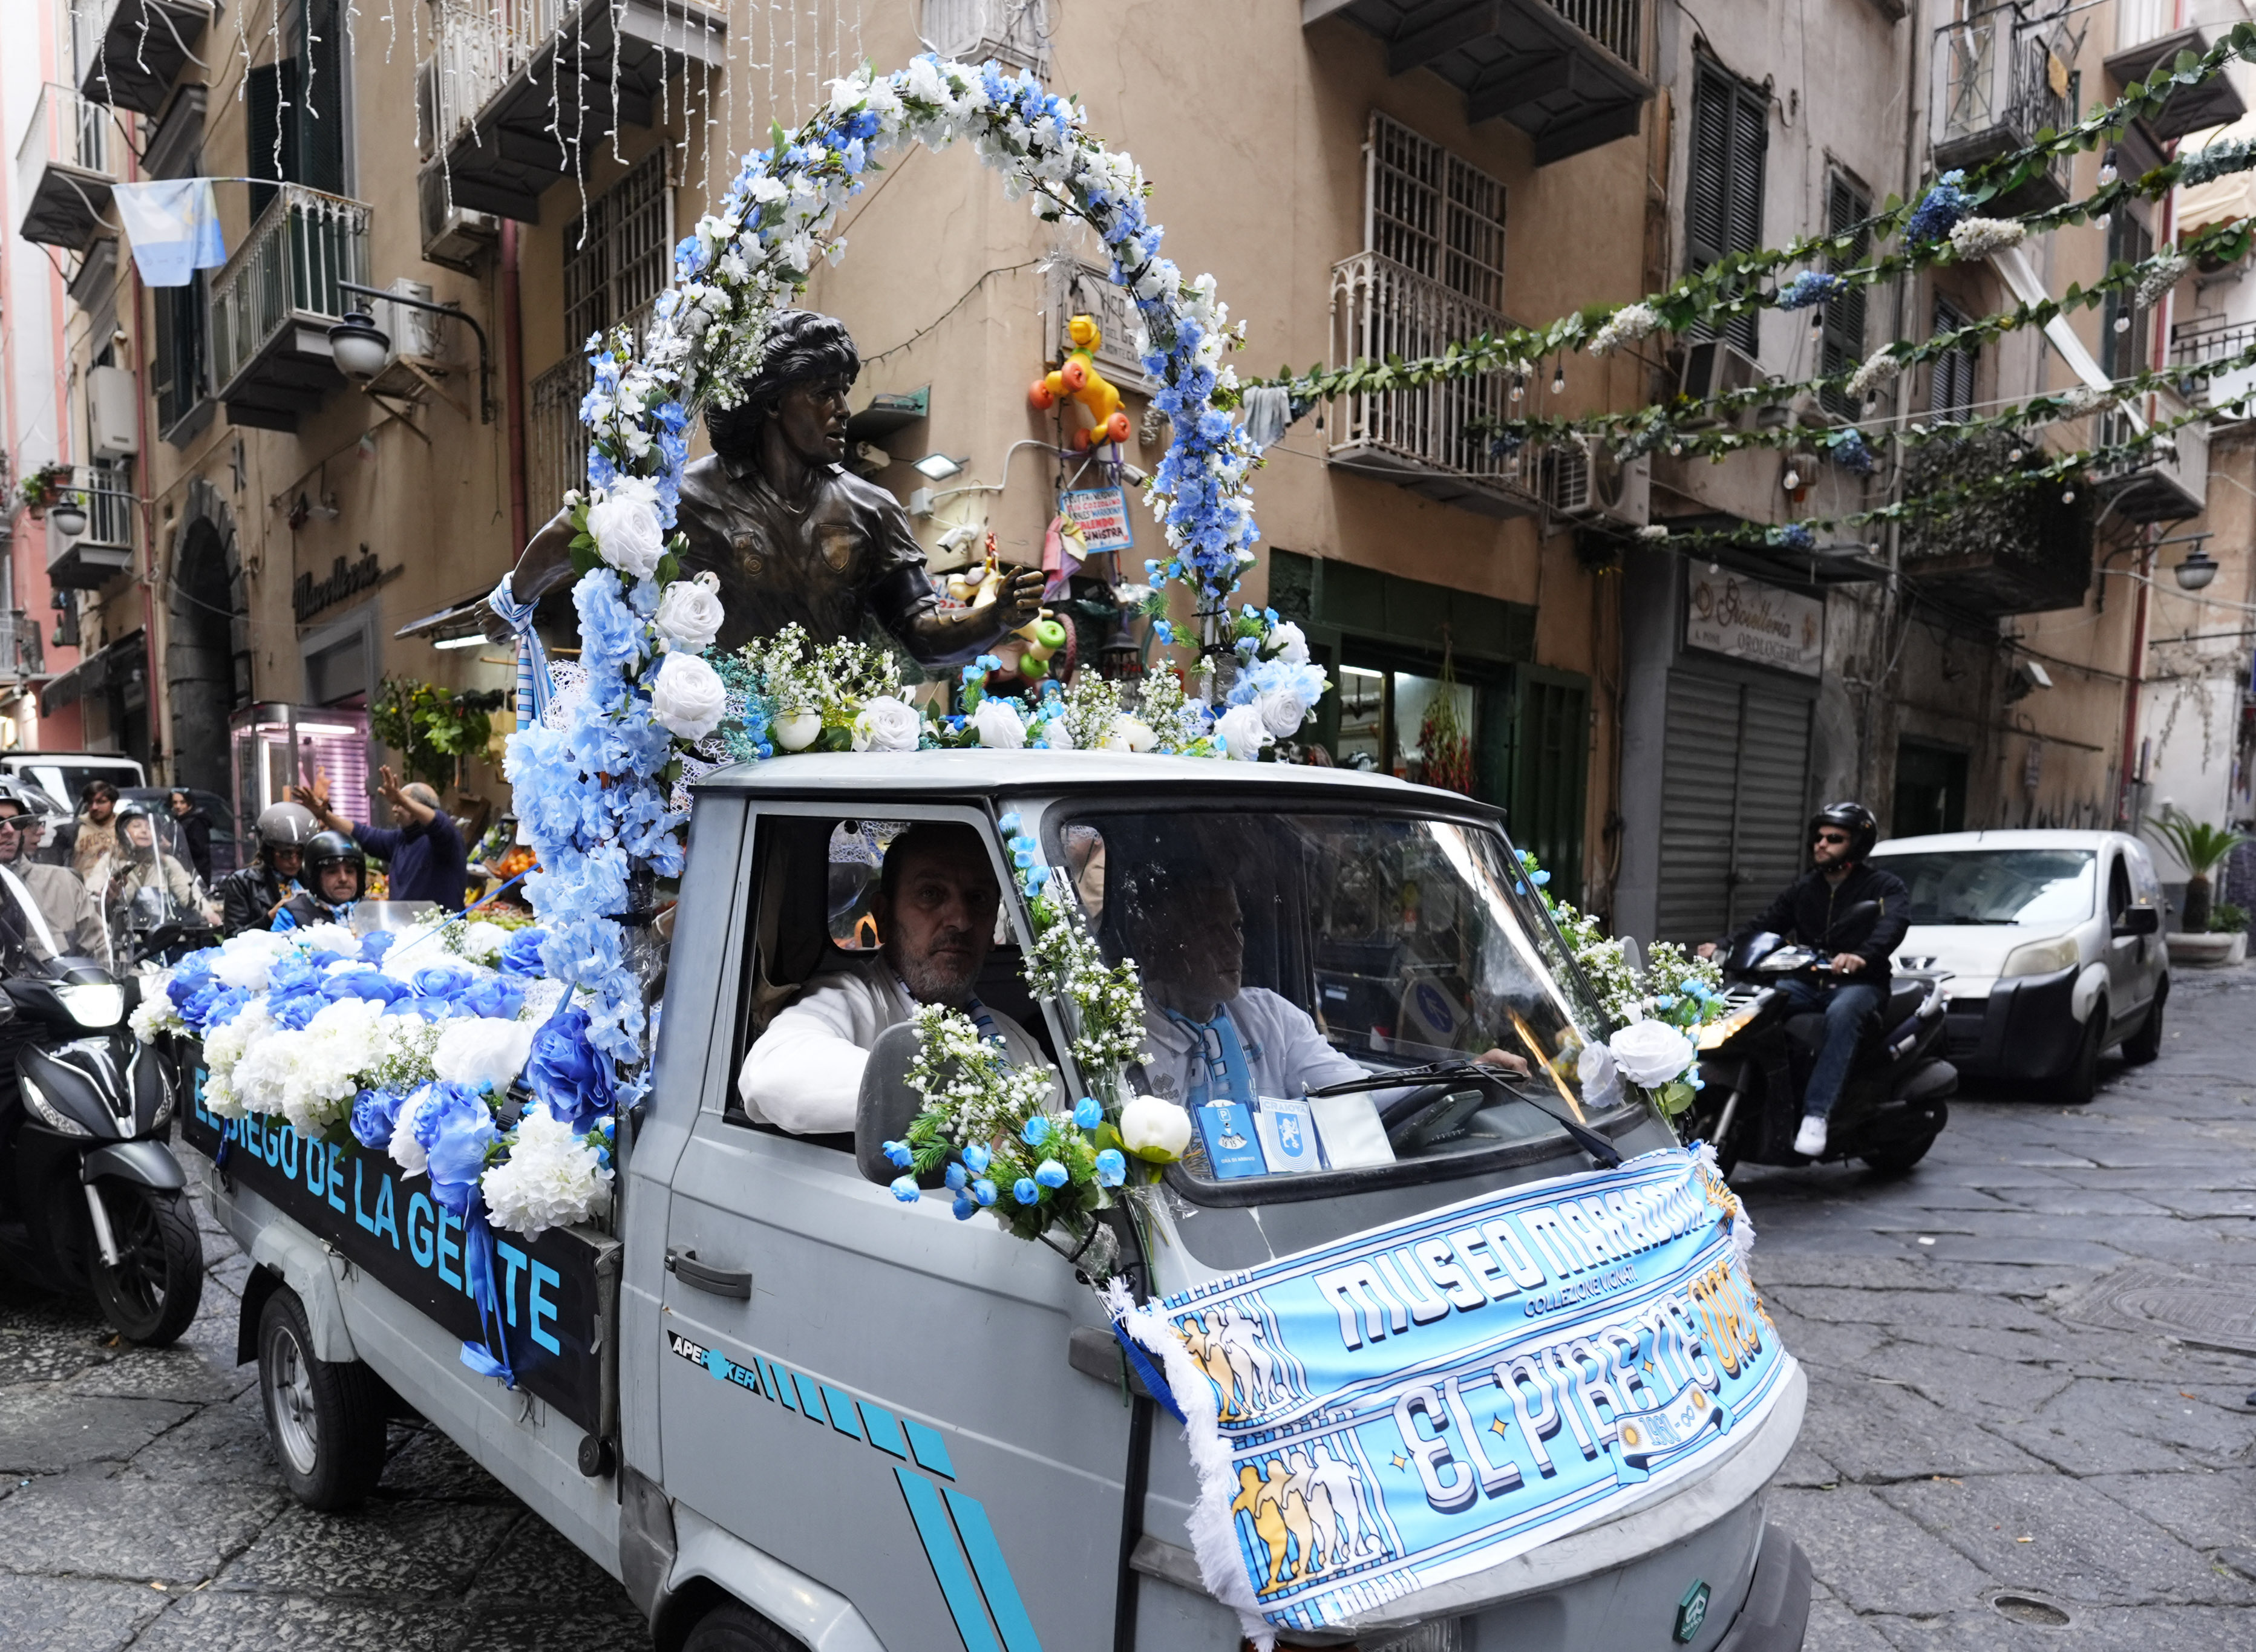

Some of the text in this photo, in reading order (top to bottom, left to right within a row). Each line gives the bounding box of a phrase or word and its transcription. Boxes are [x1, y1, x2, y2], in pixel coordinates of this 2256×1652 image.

[1263, 1101, 1307, 1114] CRAIOVA
[306, 1133, 346, 1215] DE
[355, 1157, 401, 1250] LA
[1312, 1218, 1548, 1353] MUSEO
[1524, 1276, 1601, 1318] COLLEZIONE
[1392, 1375, 1525, 1515] EL
[1638, 1413, 1682, 1446] 1960
